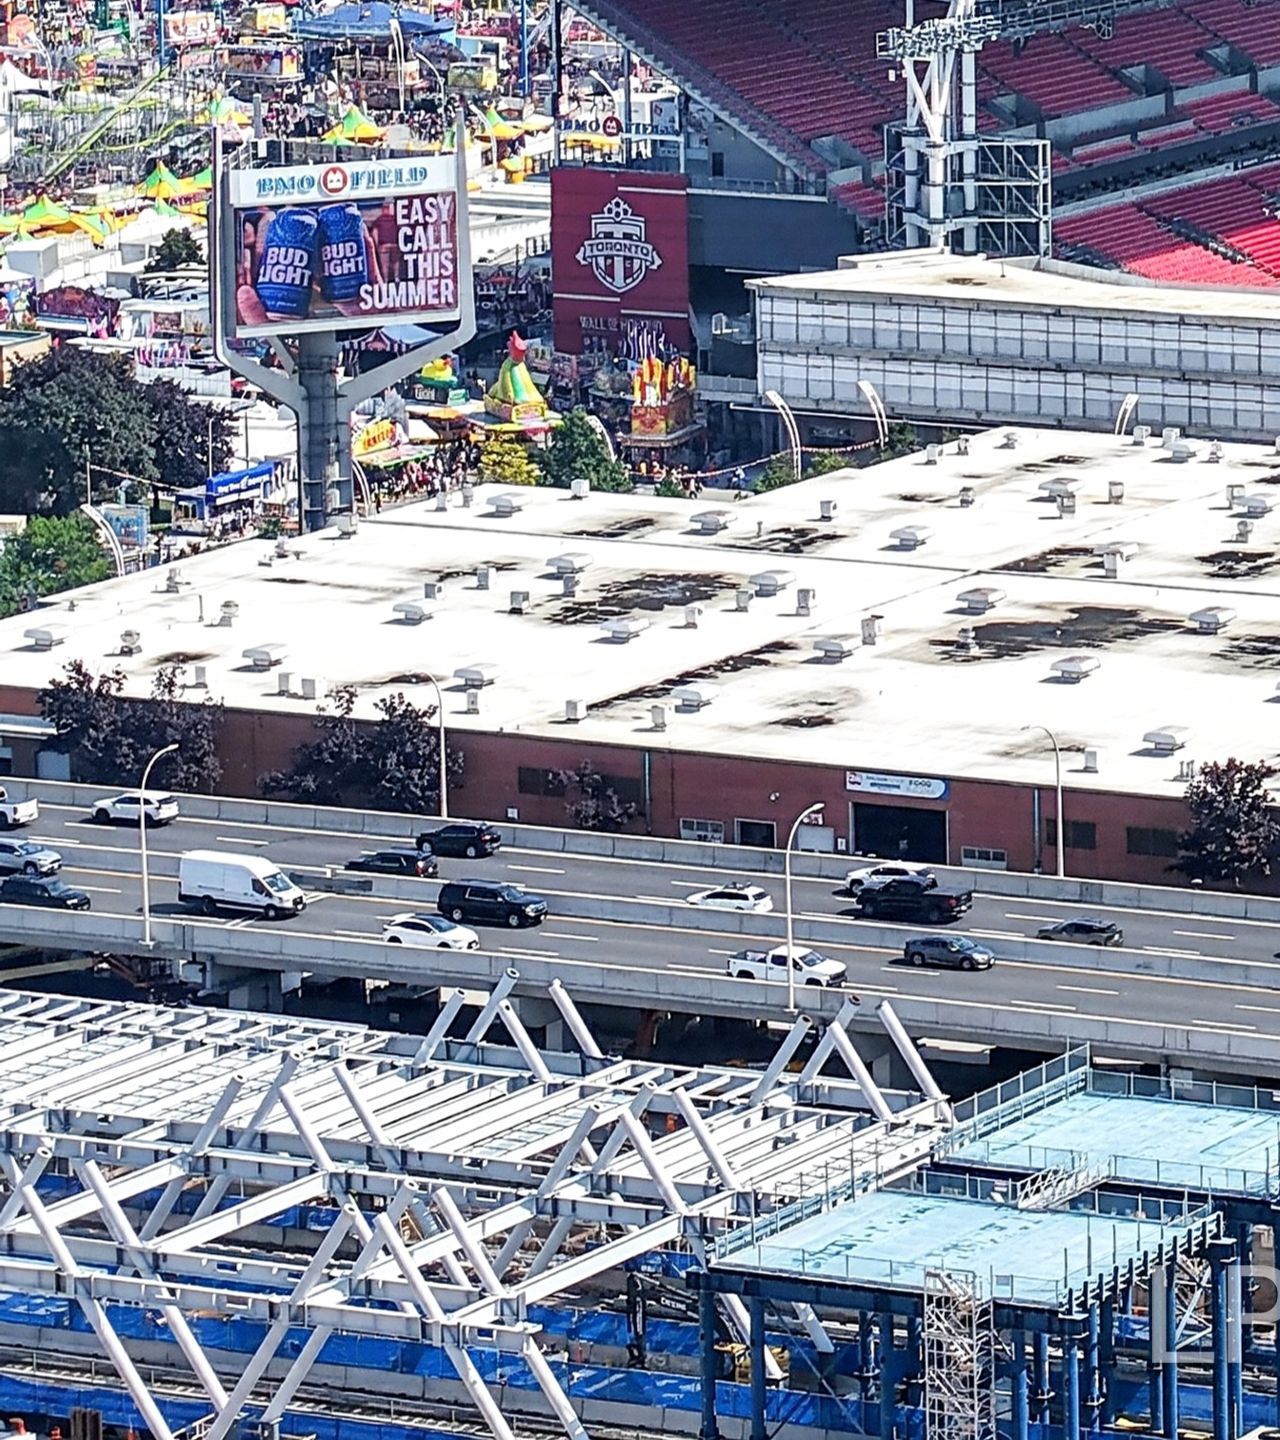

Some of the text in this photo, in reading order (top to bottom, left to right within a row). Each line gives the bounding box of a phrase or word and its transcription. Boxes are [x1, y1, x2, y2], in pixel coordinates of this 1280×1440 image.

[256, 165, 428, 197] BMO FIELD
[396, 195, 453, 225] EASY
[322, 242, 357, 260] BUD
[398, 222, 453, 252] CALL
[587, 241, 650, 257] TORONTO
[267, 246, 309, 268] BUD
[403, 250, 454, 279] THIS
[359, 278, 455, 310] SUMMER
